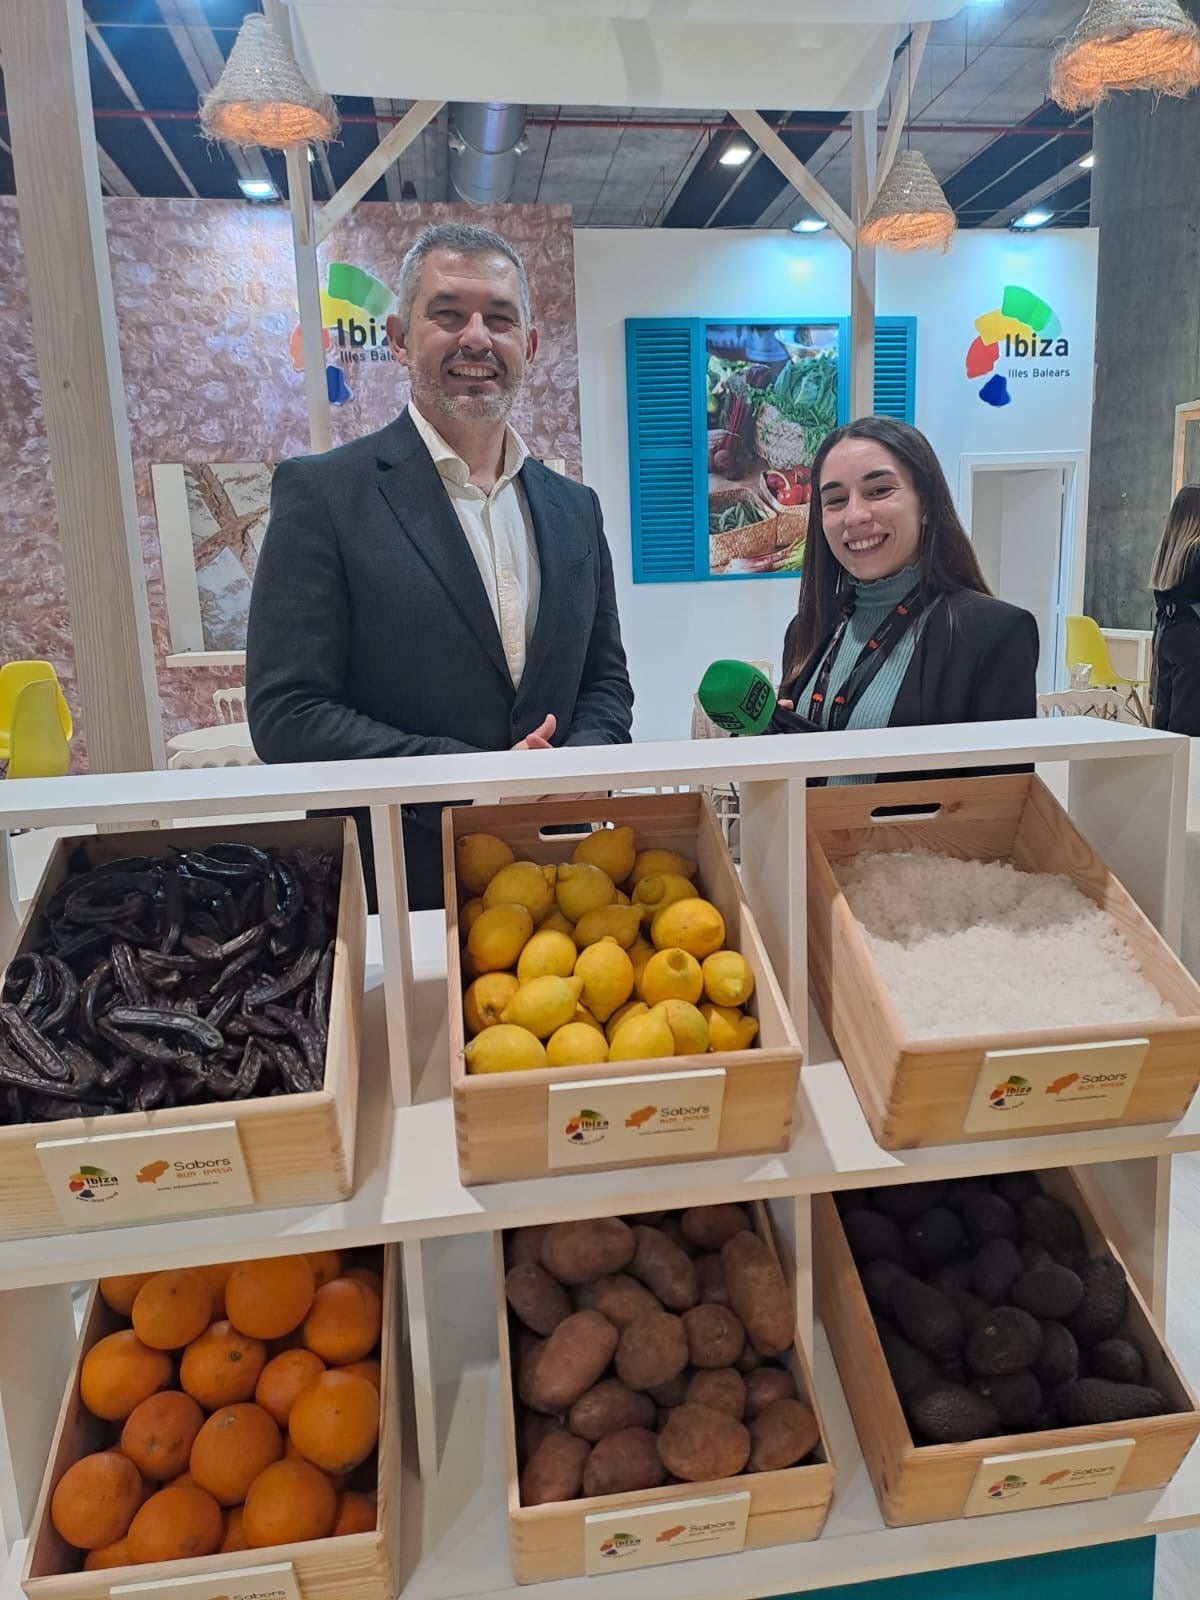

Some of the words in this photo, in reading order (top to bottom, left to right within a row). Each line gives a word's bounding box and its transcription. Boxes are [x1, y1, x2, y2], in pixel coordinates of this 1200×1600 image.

[337, 317, 388, 346] Ibi
[1005, 332, 1069, 357] Ibiza
[340, 350, 366, 363] Illes
[1008, 368, 1029, 379] Illes
[1032, 367, 1071, 378] Balears
[1081, 1072, 1128, 1084] Sabors
[660, 1105, 711, 1118] Sabors
[173, 1158, 231, 1171] Sabors
